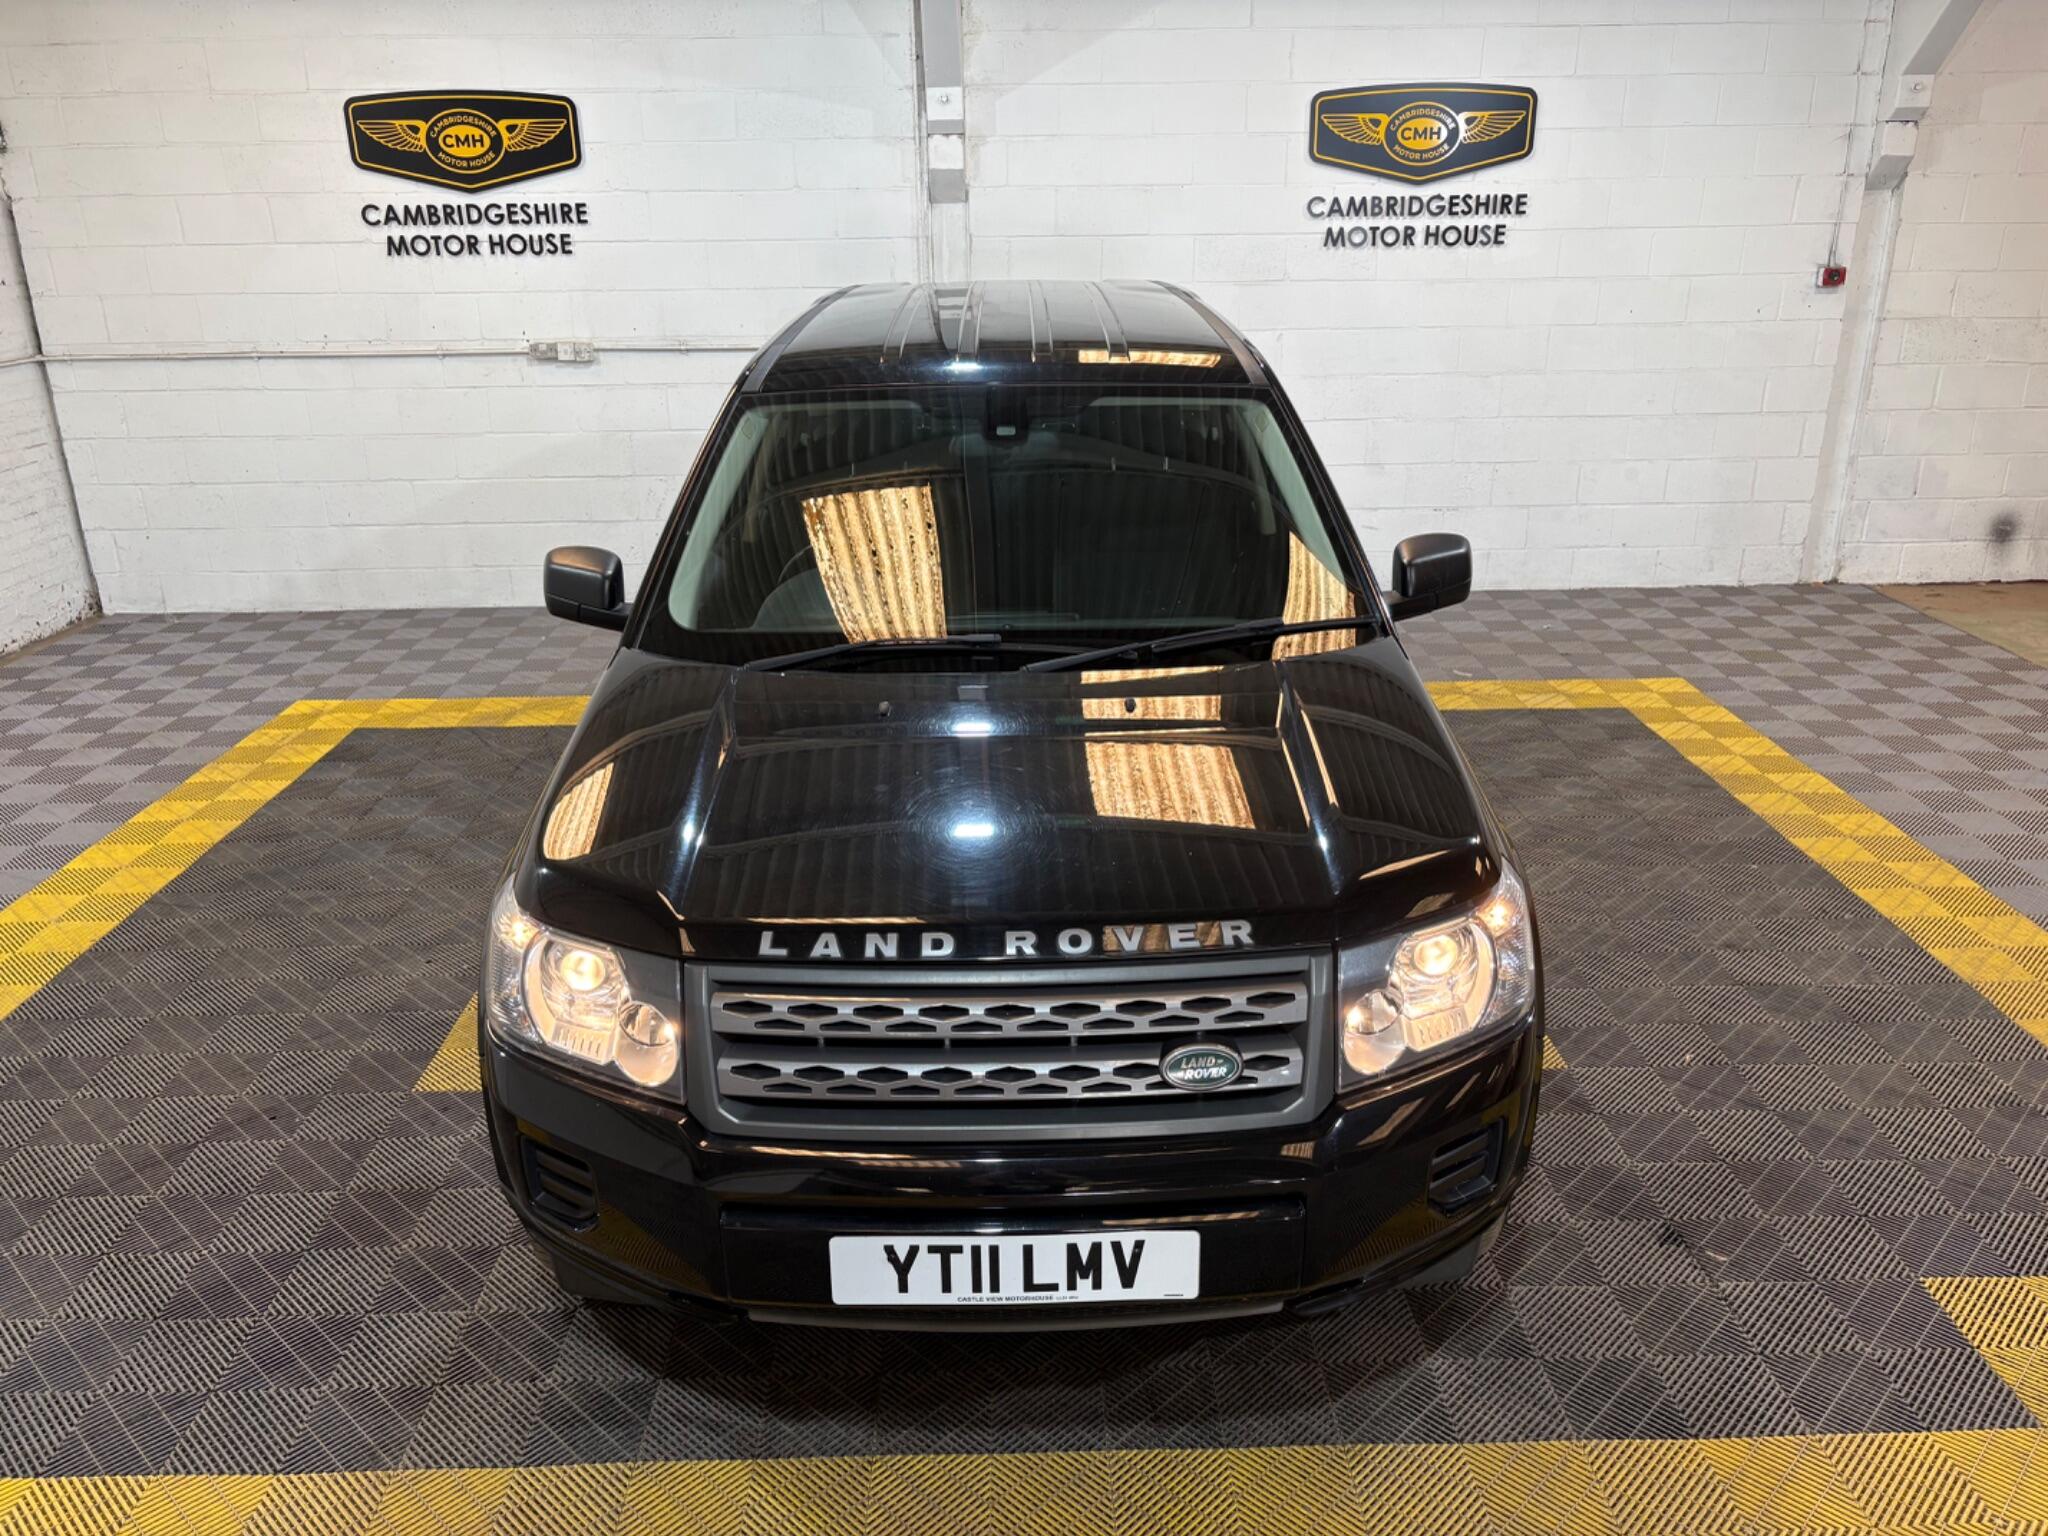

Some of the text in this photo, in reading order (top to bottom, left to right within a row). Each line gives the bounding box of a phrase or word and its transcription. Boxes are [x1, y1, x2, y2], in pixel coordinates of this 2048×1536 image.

[430, 115, 497, 138] CAMBRIDGESHIRE
[1401, 126, 1442, 141] CMH
[442, 134, 484, 148] CMH
[437, 150, 496, 168] MOTOR HOUSE
[361, 203, 588, 226] CAMBRIDGESHIRE
[1306, 193, 1528, 218] CAMBRIDGESHIRE
[386, 233, 573, 257] MOTOR HOUSE
[1323, 224, 1507, 248] MOTOR HOUSE
[758, 919, 1256, 959] LAND ROVER
[883, 1239, 1146, 1294] YT11 LMV
